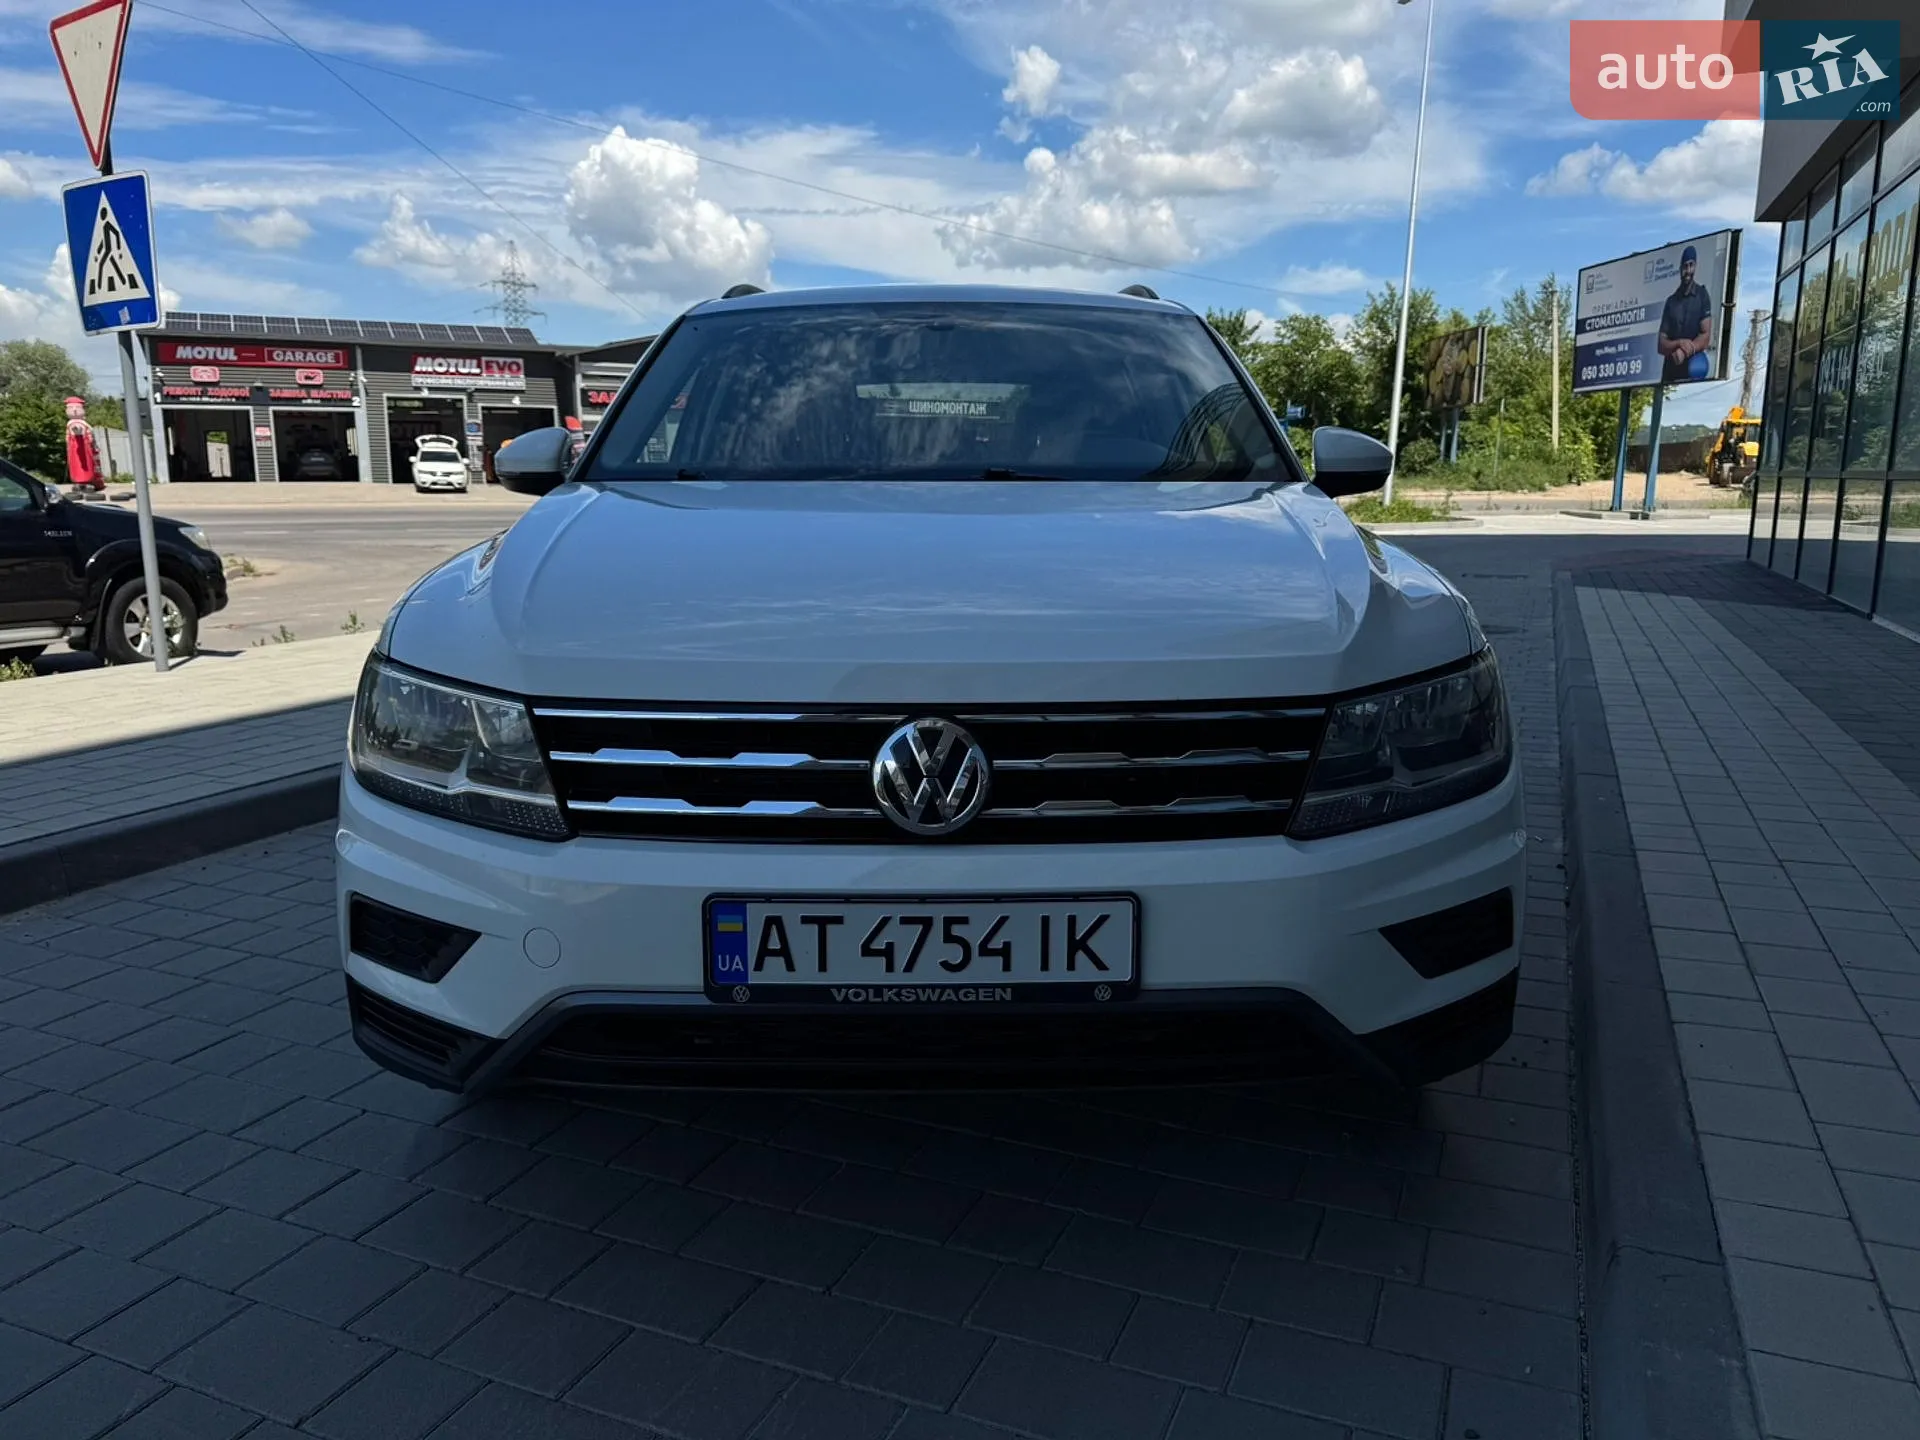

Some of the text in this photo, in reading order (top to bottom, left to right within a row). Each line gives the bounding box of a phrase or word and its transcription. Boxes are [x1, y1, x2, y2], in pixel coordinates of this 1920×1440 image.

[1585, 308, 1646, 330] СТОМАТОЛОГІЯ
[175, 346, 336, 363] MOTUL GARAGE
[415, 357, 521, 376] MOTUL EVO
[1581, 360, 1642, 381] 050 330 00 99
[154, 392, 161, 403] 1
[352, 397, 361, 407] 2
[909, 400, 987, 416] ШИНОМОНТАЖ
[753, 914, 1111, 973] AT 4754 IK
[718, 954, 744, 972] UA
[830, 987, 1013, 1002] VOLKSWAGEN
